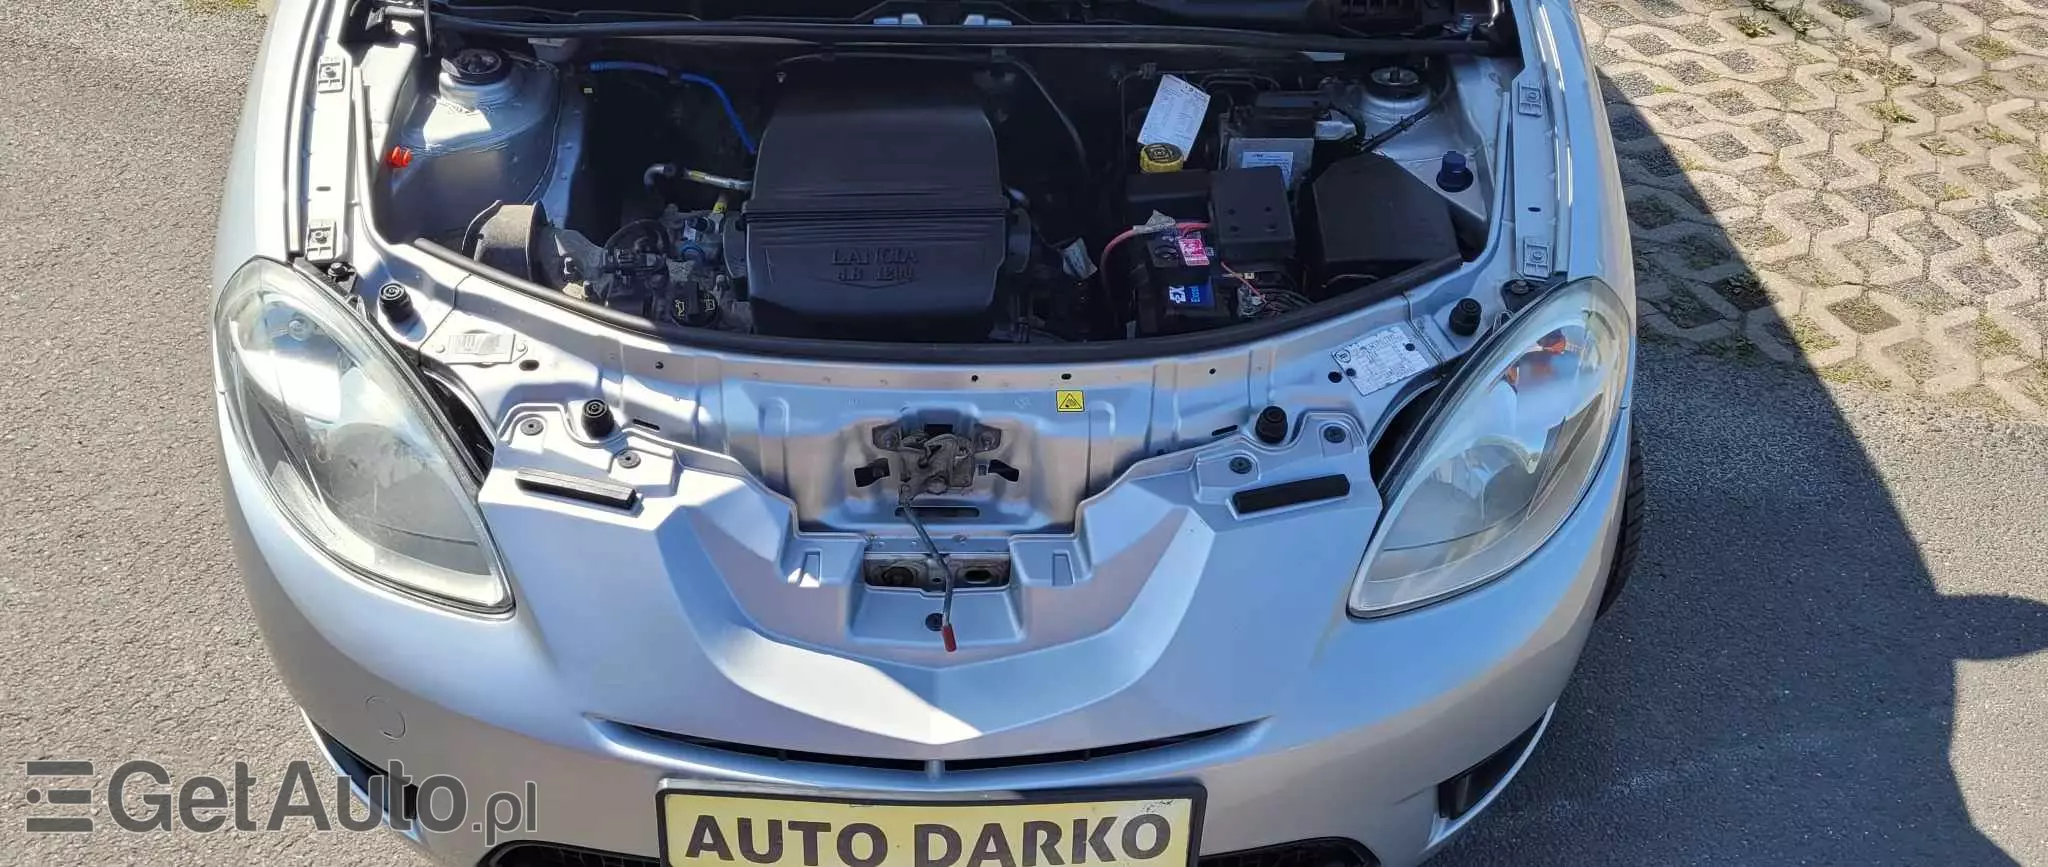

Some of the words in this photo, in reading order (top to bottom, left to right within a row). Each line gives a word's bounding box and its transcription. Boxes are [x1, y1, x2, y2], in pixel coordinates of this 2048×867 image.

[831, 247, 919, 266] LANCIA
[685, 814, 888, 867] AUTO
[914, 813, 1171, 867] DARKO
